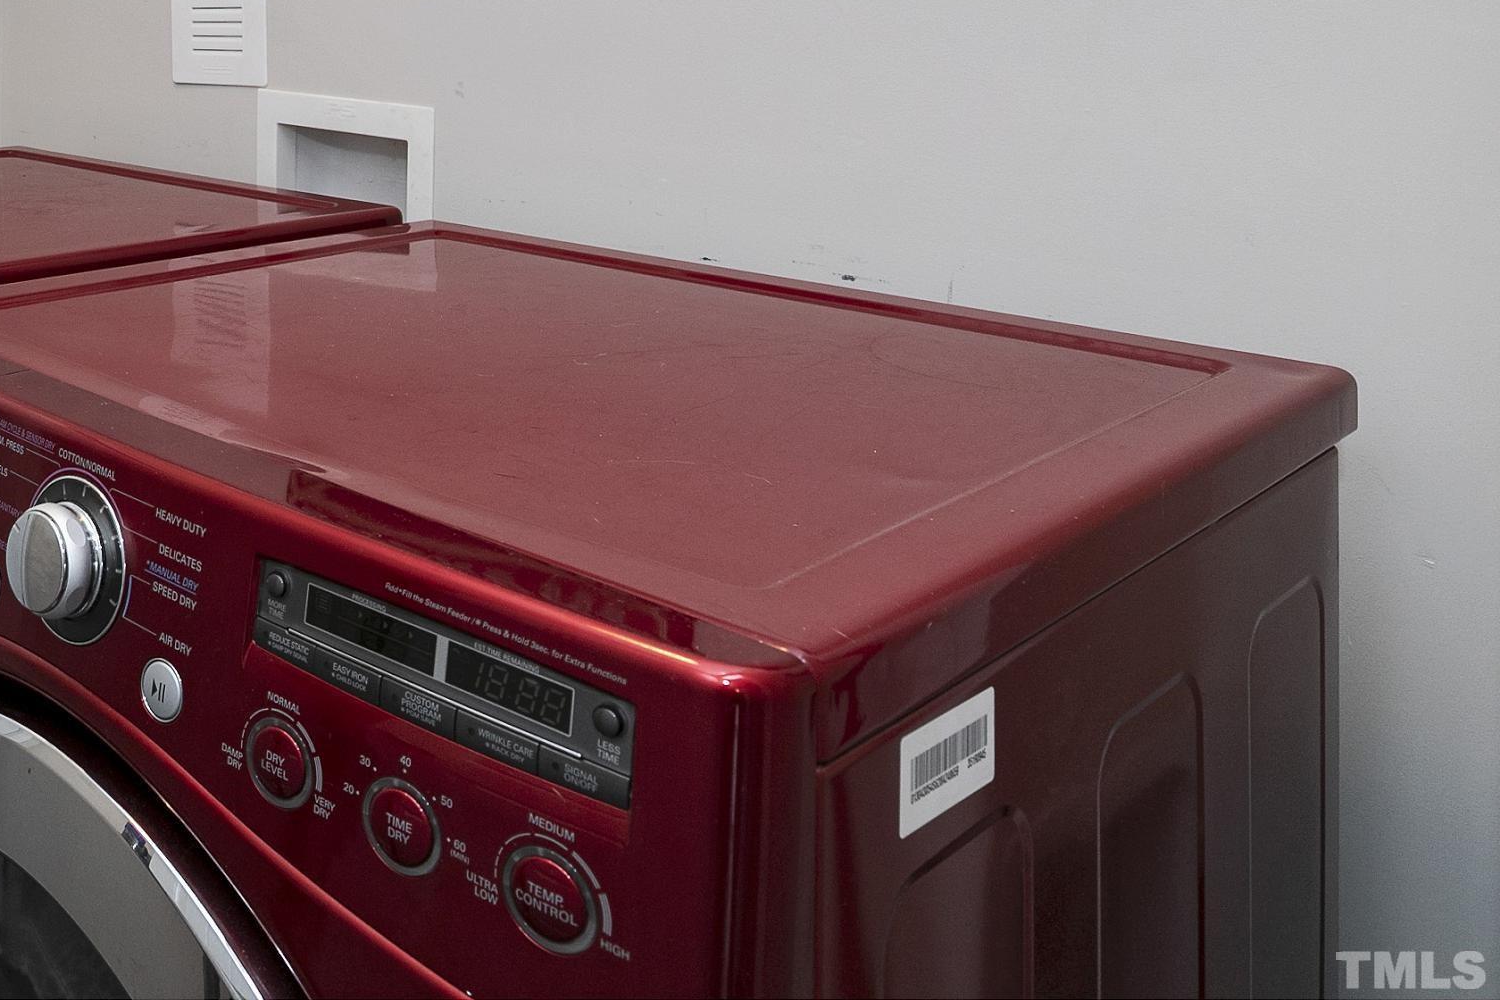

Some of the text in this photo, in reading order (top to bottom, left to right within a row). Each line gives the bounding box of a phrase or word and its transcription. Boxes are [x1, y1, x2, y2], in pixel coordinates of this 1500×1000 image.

[5, 438, 25, 455] PRESS
[155, 507, 207, 538] HEAVY DUTY
[158, 543, 203, 572] DELICATES
[149, 561, 200, 592] MANUAL DRY
[152, 581, 197, 611] SPEED DRY
[267, 599, 287, 612] MORE
[268, 607, 285, 620] TIME
[158, 632, 193, 657] AIR DRY
[268, 631, 309, 656] REDUCE STATIC
[413, 593, 424, 604] the
[424, 598, 446, 613] Steam
[446, 607, 470, 623] Feeder
[482, 621, 502, 637] Press
[503, 630, 510, 638] &
[511, 632, 530, 647] Hold
[552, 649, 563, 660] for
[564, 654, 586, 670] Extra
[586, 663, 627, 686] Functions
[332, 662, 369, 685] EASY IRON
[266, 691, 301, 716] NORMAL
[400, 699, 442, 722] PROGRAM
[404, 691, 440, 712] CUSTOM
[221, 742, 243, 761] DAMP
[477, 728, 535, 758] WRINKLE CARE
[596, 739, 621, 755] LESS
[227, 757, 243, 771] DRY
[265, 750, 286, 768] DRY
[359, 754, 372, 768] 30
[399, 754, 412, 768] 40
[597, 748, 620, 766] TIME
[260, 758, 289, 782] LEVEL
[564, 763, 599, 786] SIGNAL
[342, 781, 355, 795] 20
[563, 772, 598, 793] ON/OFF
[313, 804, 331, 820] DRY
[314, 794, 336, 812] VERY
[440, 794, 453, 809] 50
[385, 811, 413, 834] TIME
[528, 813, 576, 843] MEDIUM
[387, 826, 411, 846] DRY
[453, 839, 467, 853] 60
[450, 849, 471, 865] (MIN)
[466, 869, 499, 895] ULTRA
[474, 886, 499, 906] LOW
[527, 880, 565, 908] TEMP.
[515, 888, 580, 928] CONTROL
[600, 938, 631, 961] HIGH
